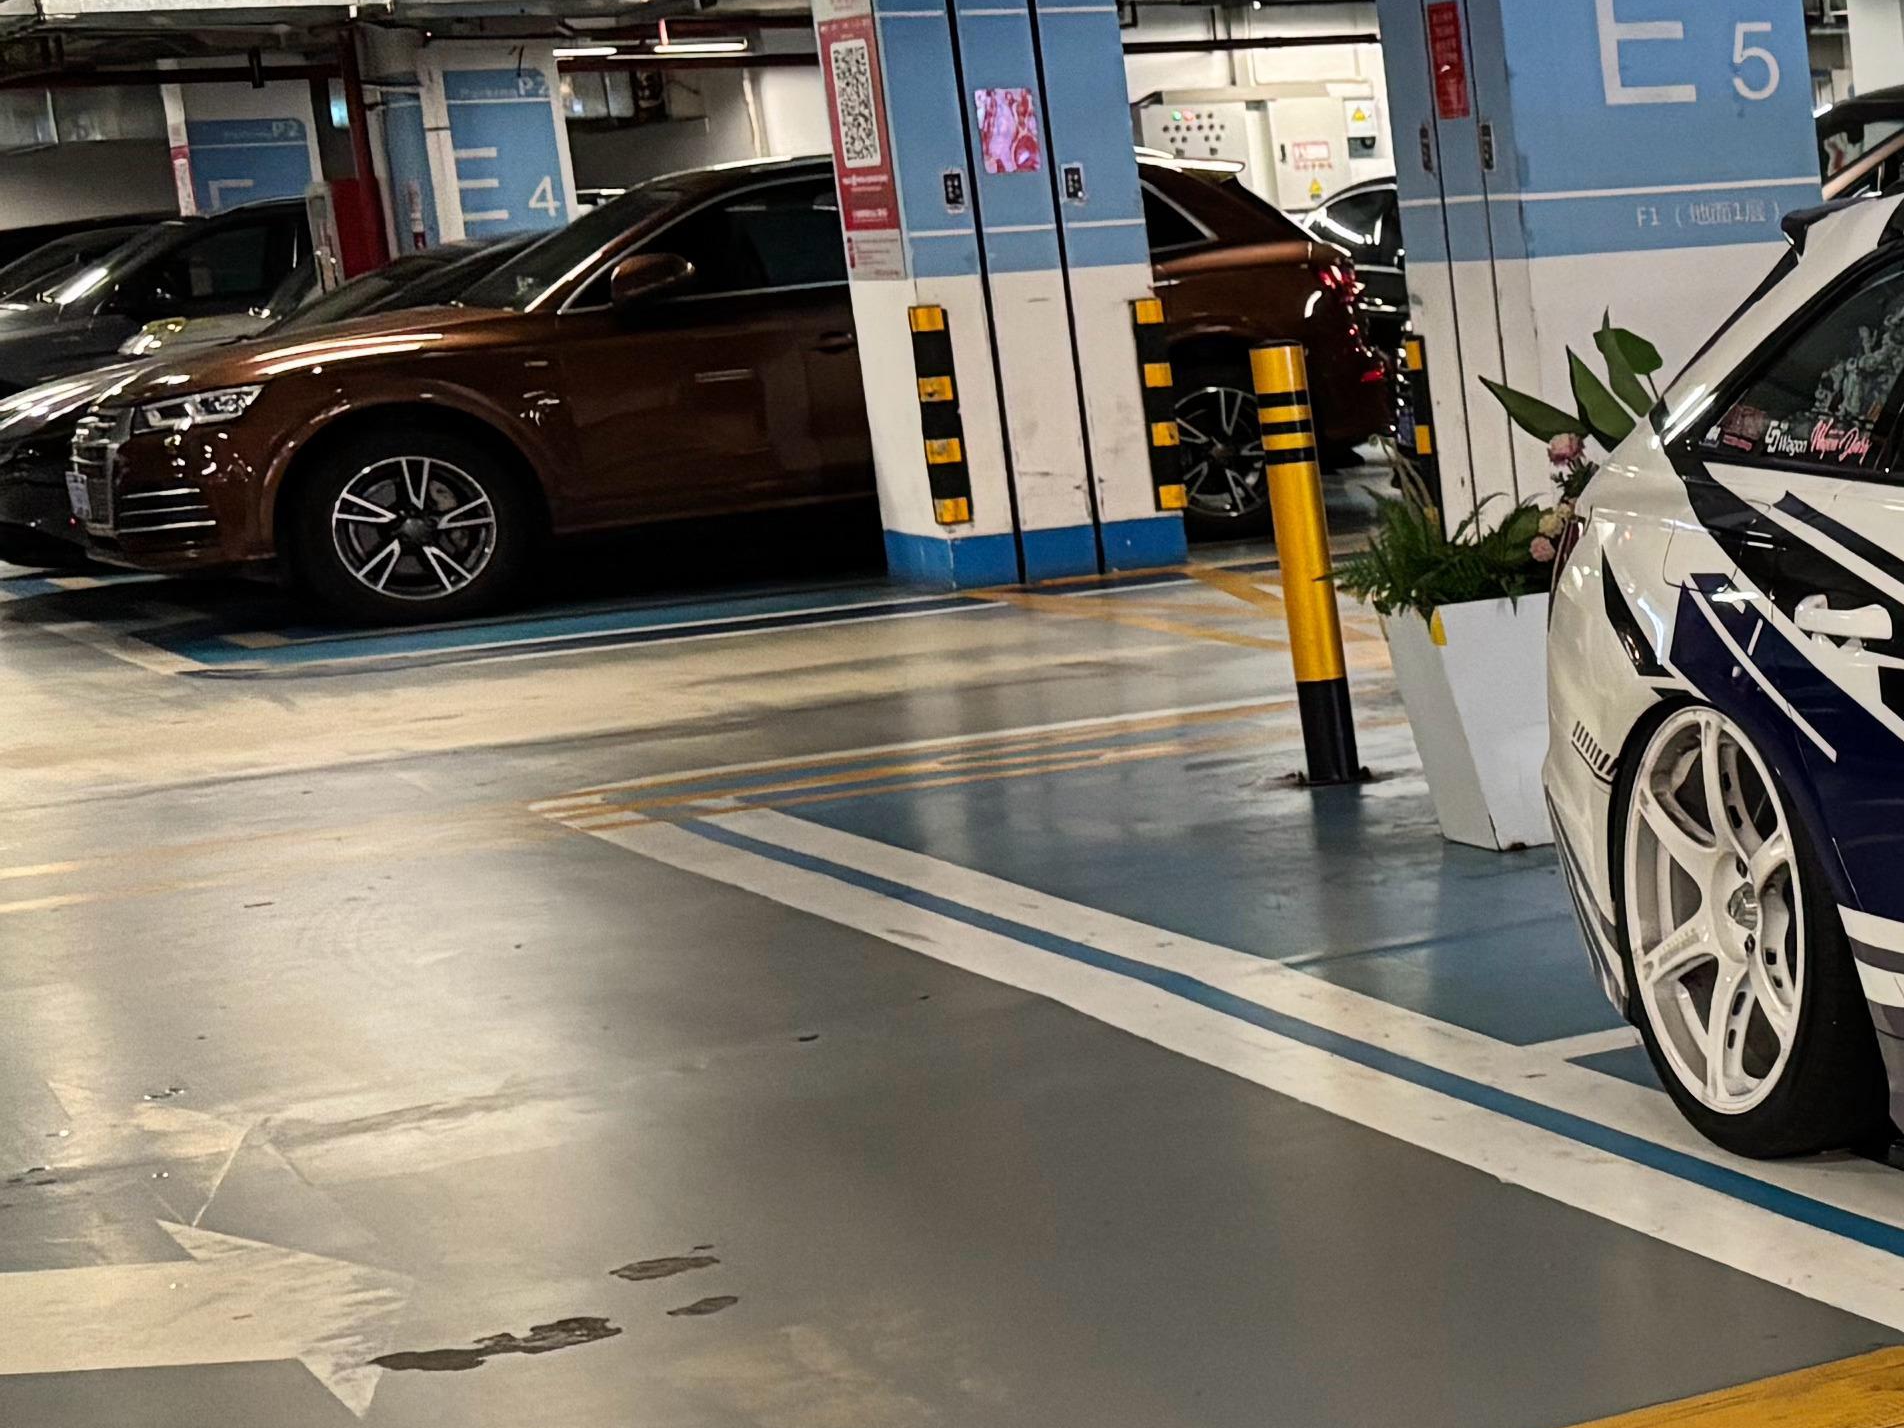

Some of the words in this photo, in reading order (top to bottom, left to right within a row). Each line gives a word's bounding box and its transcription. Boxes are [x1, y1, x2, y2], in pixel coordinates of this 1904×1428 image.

[1732, 22, 1780, 100] 5
[528, 175, 561, 218] 4
[1778, 434, 1808, 456] Wagon
